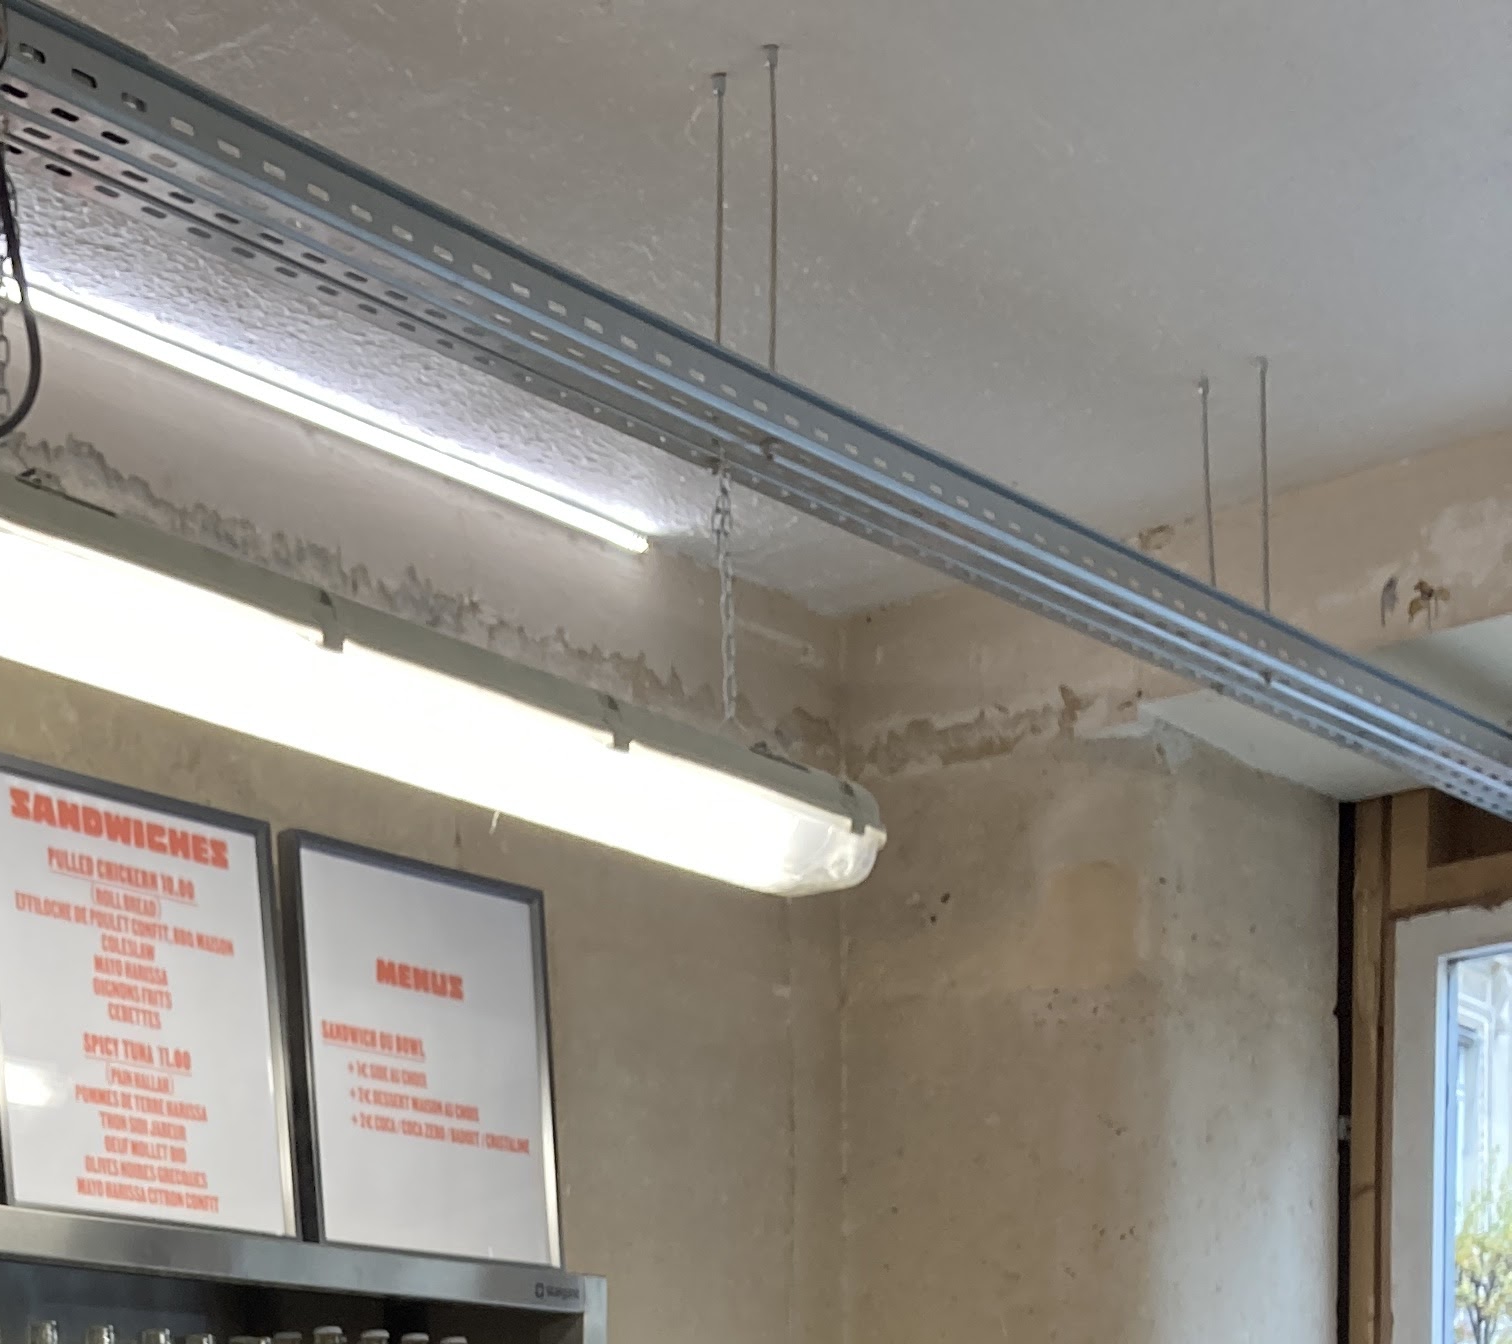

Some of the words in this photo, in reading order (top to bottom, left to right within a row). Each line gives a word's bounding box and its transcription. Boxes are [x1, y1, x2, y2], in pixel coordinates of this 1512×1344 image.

[9, 786, 230, 870] SANDWICHES
[47, 846, 94, 878] PULLED
[101, 932, 155, 961] COLESLAW
[376, 957, 464, 1001] MENUS
[83, 1032, 119, 1058] SPICY
[121, 1039, 154, 1065] TUNA
[321, 1019, 377, 1048] SANDWICH
